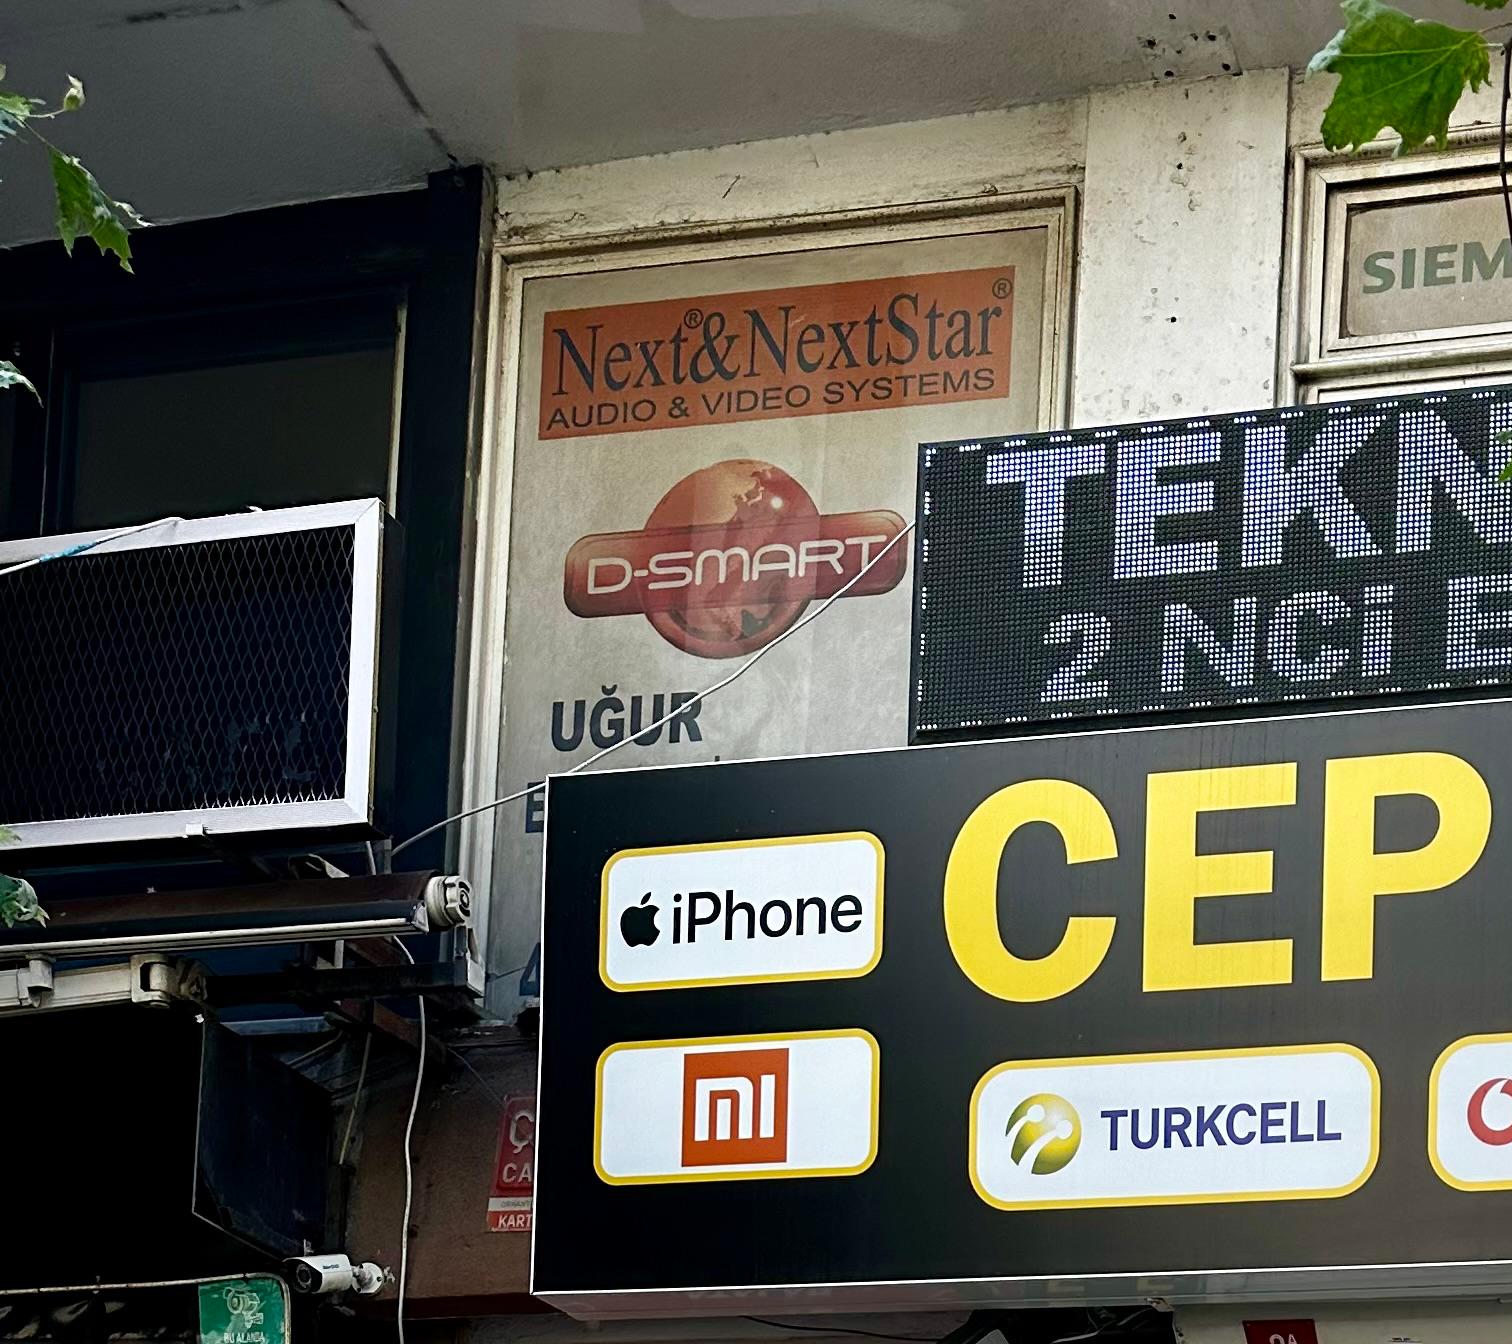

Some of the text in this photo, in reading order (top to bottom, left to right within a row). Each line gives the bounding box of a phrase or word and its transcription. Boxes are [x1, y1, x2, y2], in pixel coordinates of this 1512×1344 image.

[546, 367, 996, 432] AUDIO & VIDEO SYSTEMS
[587, 535, 888, 596] D-SMART
[1040, 611, 1113, 704] 2
[550, 685, 703, 752] UĞUR
[942, 750, 1493, 1004] CEP
[672, 889, 863, 945] iPhone
[1101, 1098, 1343, 1153] TURKCELL
[498, 1214, 534, 1229] KART
